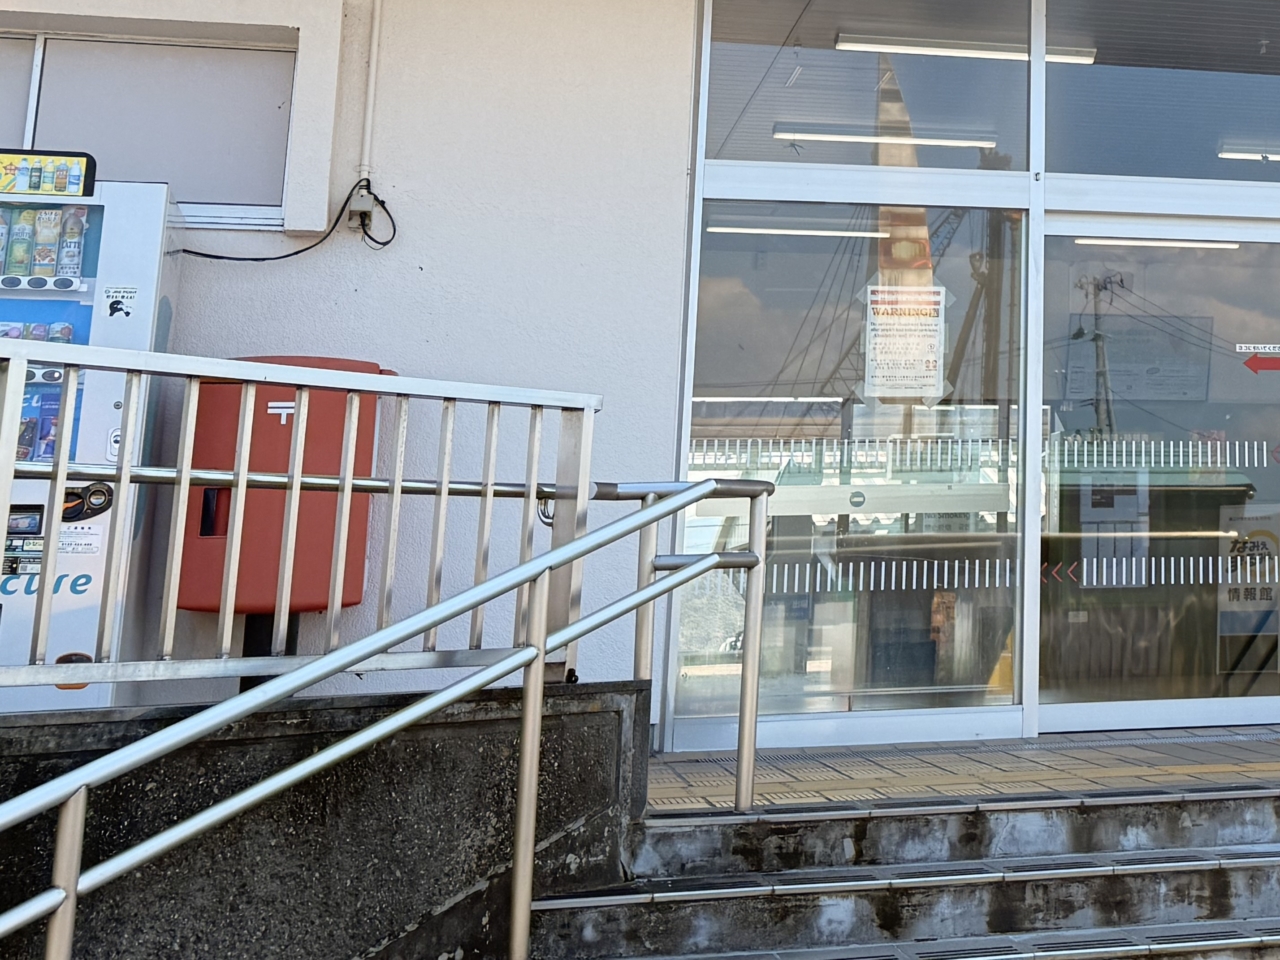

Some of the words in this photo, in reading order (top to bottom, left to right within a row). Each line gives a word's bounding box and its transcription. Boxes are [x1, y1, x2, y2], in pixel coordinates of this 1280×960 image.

[871, 307, 928, 316] WARNING
[1227, 587, 1273, 602] 情報館
